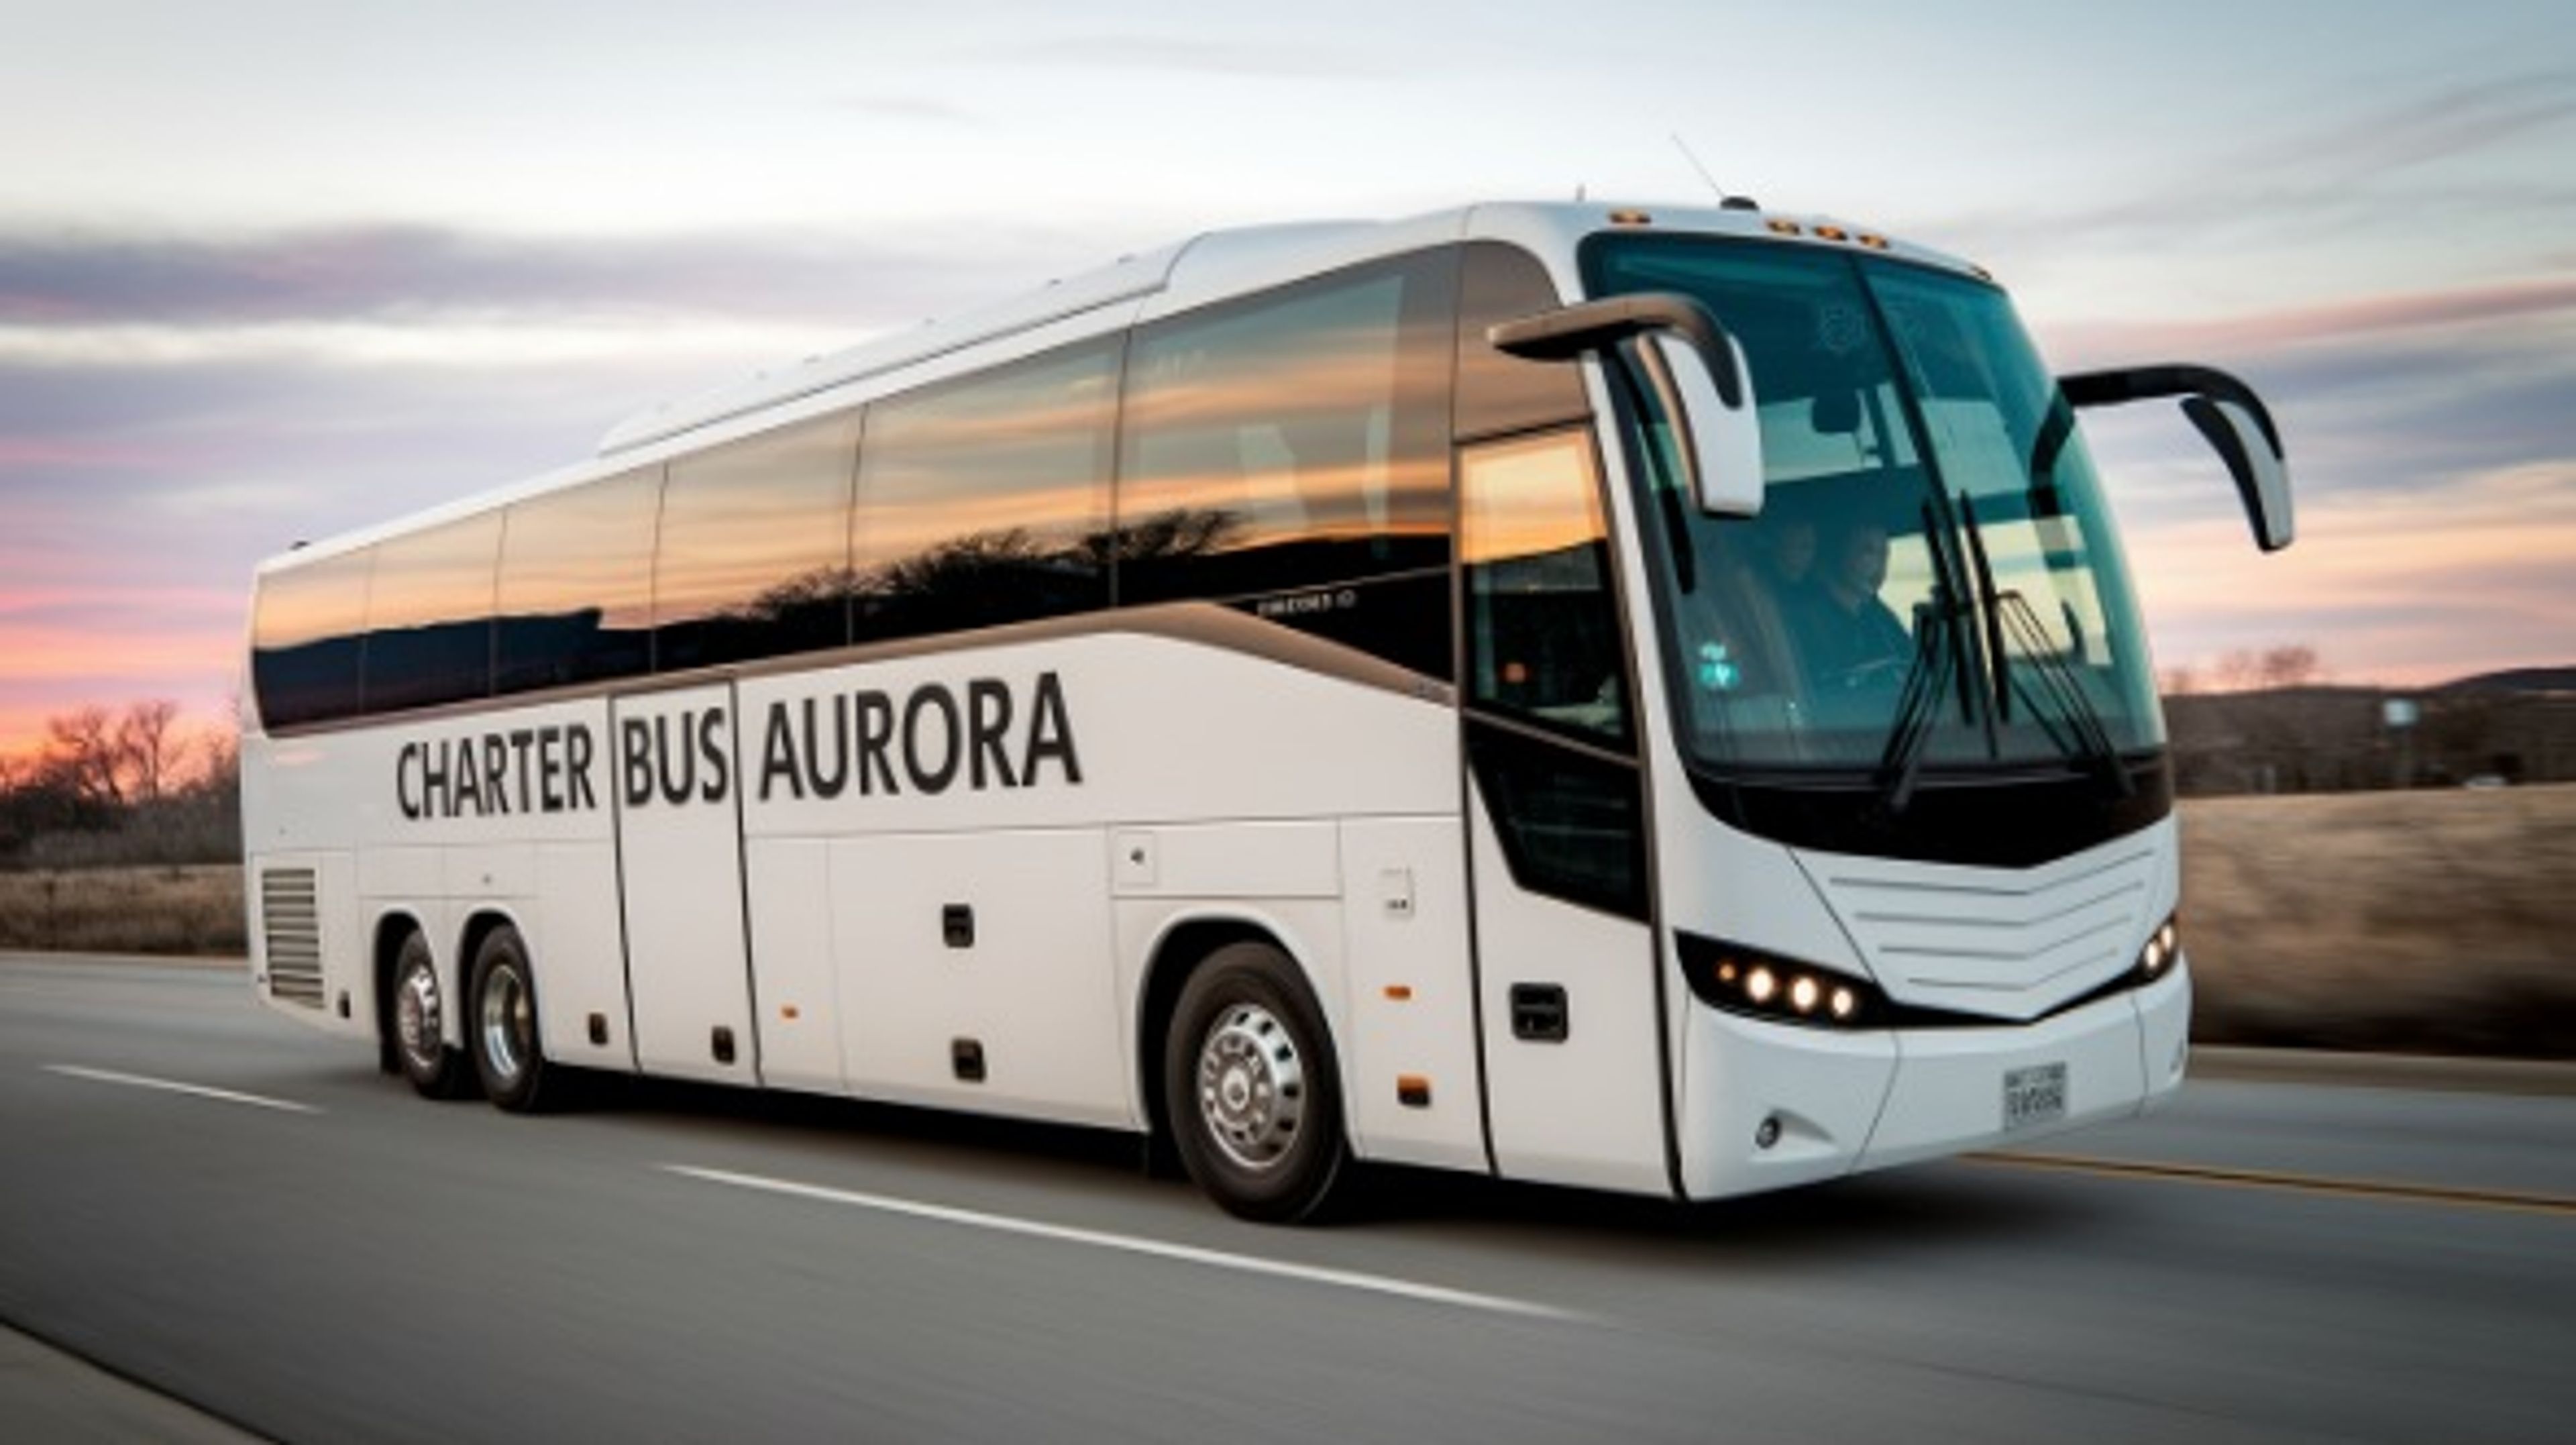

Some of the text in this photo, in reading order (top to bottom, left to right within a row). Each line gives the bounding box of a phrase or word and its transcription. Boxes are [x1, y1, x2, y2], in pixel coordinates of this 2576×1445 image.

[396, 670, 1083, 821] CHARTER BUS AURORA
